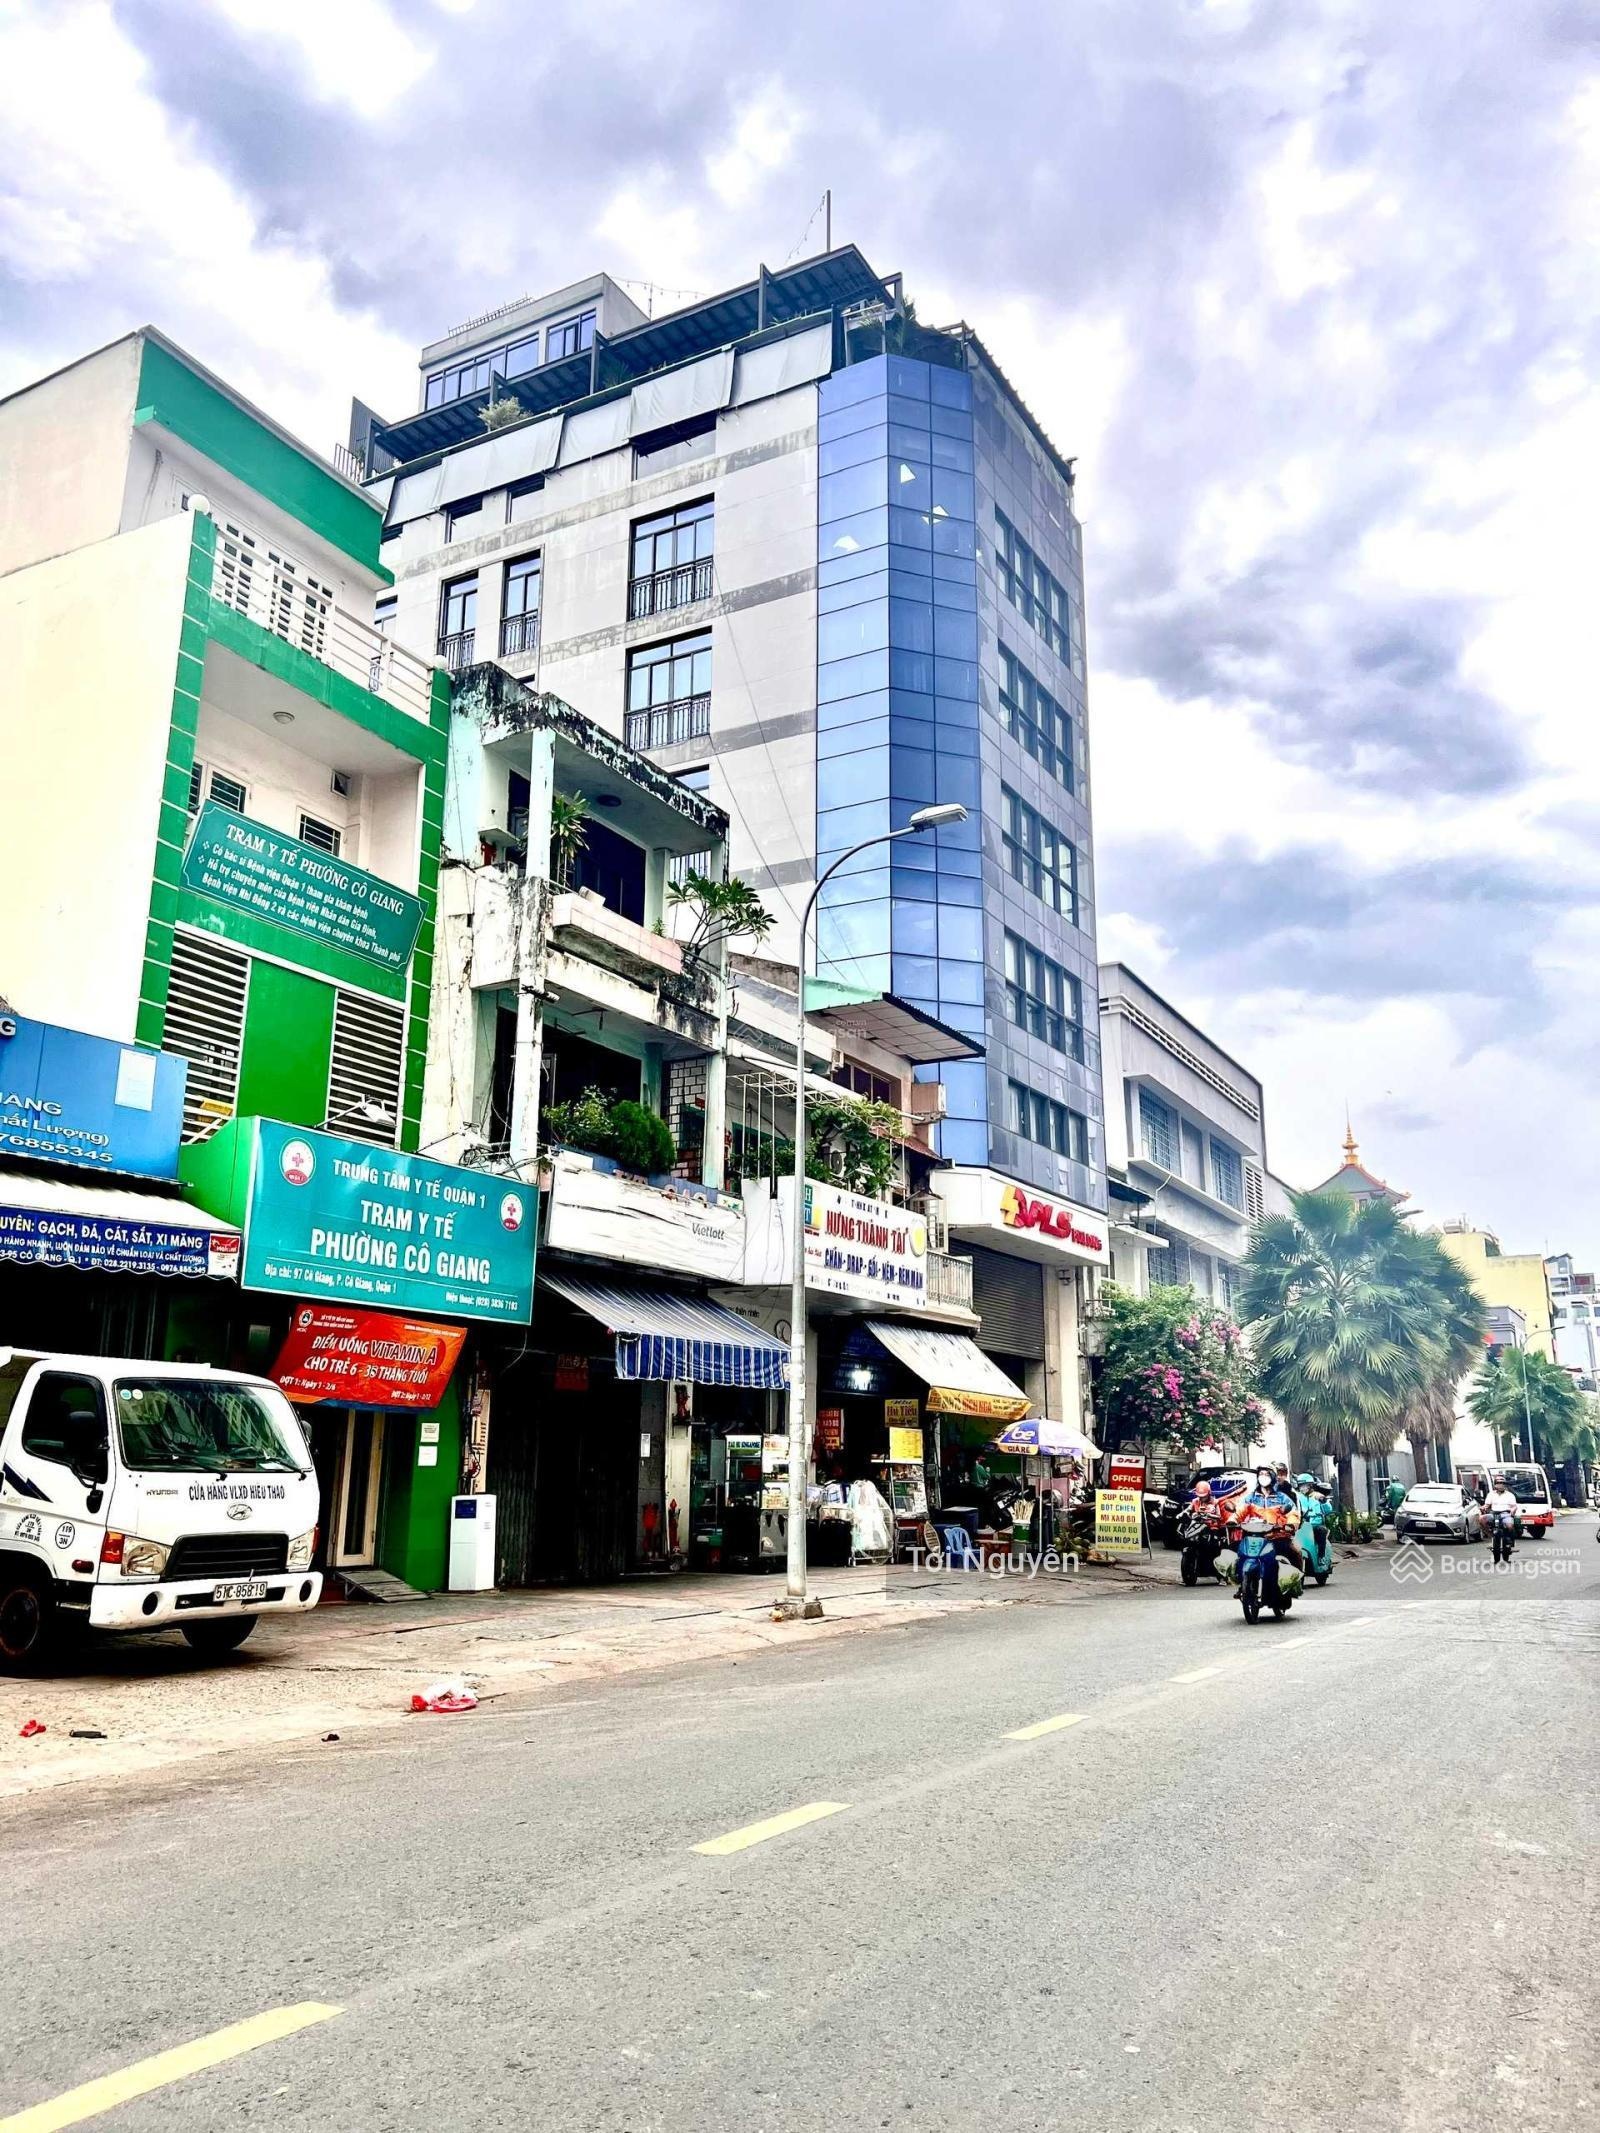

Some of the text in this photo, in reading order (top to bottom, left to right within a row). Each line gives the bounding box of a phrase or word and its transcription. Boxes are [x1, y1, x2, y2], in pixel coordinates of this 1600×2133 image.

[212, 843, 223, 856] Có
[247, 858, 265, 875] Bệnh
[266, 868, 281, 882] viện
[282, 874, 300, 890] Quận
[301, 883, 306, 892] 1
[306, 885, 323, 900] tham
[323, 893, 335, 904] gia
[335, 896, 353, 913] khám
[352, 904, 369, 920] bệnh
[226, 824, 405, 915] TRẠM Y TẾ PHƯỜNG CÔ GIANG
[202, 872, 221, 889] Bệnh
[223, 882, 238, 896] viện
[270, 901, 277, 912] 2
[278, 905, 286, 916] và
[287, 910, 300, 920] các
[300, 914, 317, 929] bệnh
[317, 922, 332, 935] viện
[355, 936, 370, 950] khoa
[288, 891, 305, 908] Bệnh
[306, 899, 320, 914] viện
[351, 919, 361, 931] Gia
[33, 1119, 110, 1147] Lượng)
[332, 1159, 487, 1209] TRUNG TÂM Y TẾ QUẬN 1
[38, 1221, 78, 1239] GẠCH,
[81, 1224, 101, 1241] ĐÁ,
[104, 1225, 129, 1244] CÁT,
[132, 1226, 153, 1246] SẮT,
[156, 1234, 167, 1245] XI
[170, 1233, 203, 1249] MĂNG
[361, 1200, 457, 1240] TRẠM Y TẾ
[827, 1210, 855, 1240] HƯNG
[856, 1219, 888, 1250] THÀNH
[19, 1250, 33, 1260] CÔ
[35, 1253, 62, 1263] GIANG
[310, 1228, 491, 1285] PHƯỜNG CÔ GIANG
[293, 1267, 303, 1280] 97
[336, 1274, 343, 1286] P.
[312, 1333, 438, 1365] ĐIỂM UỐNG VITAMIN A
[304, 1356, 429, 1384] CHO TRẺ 6 THÁNG TUỔI
[229, 1485, 249, 1500] VLXD
[1112, 1474, 1142, 1483] OFFICE
[62, 1525, 72, 1533] 119
